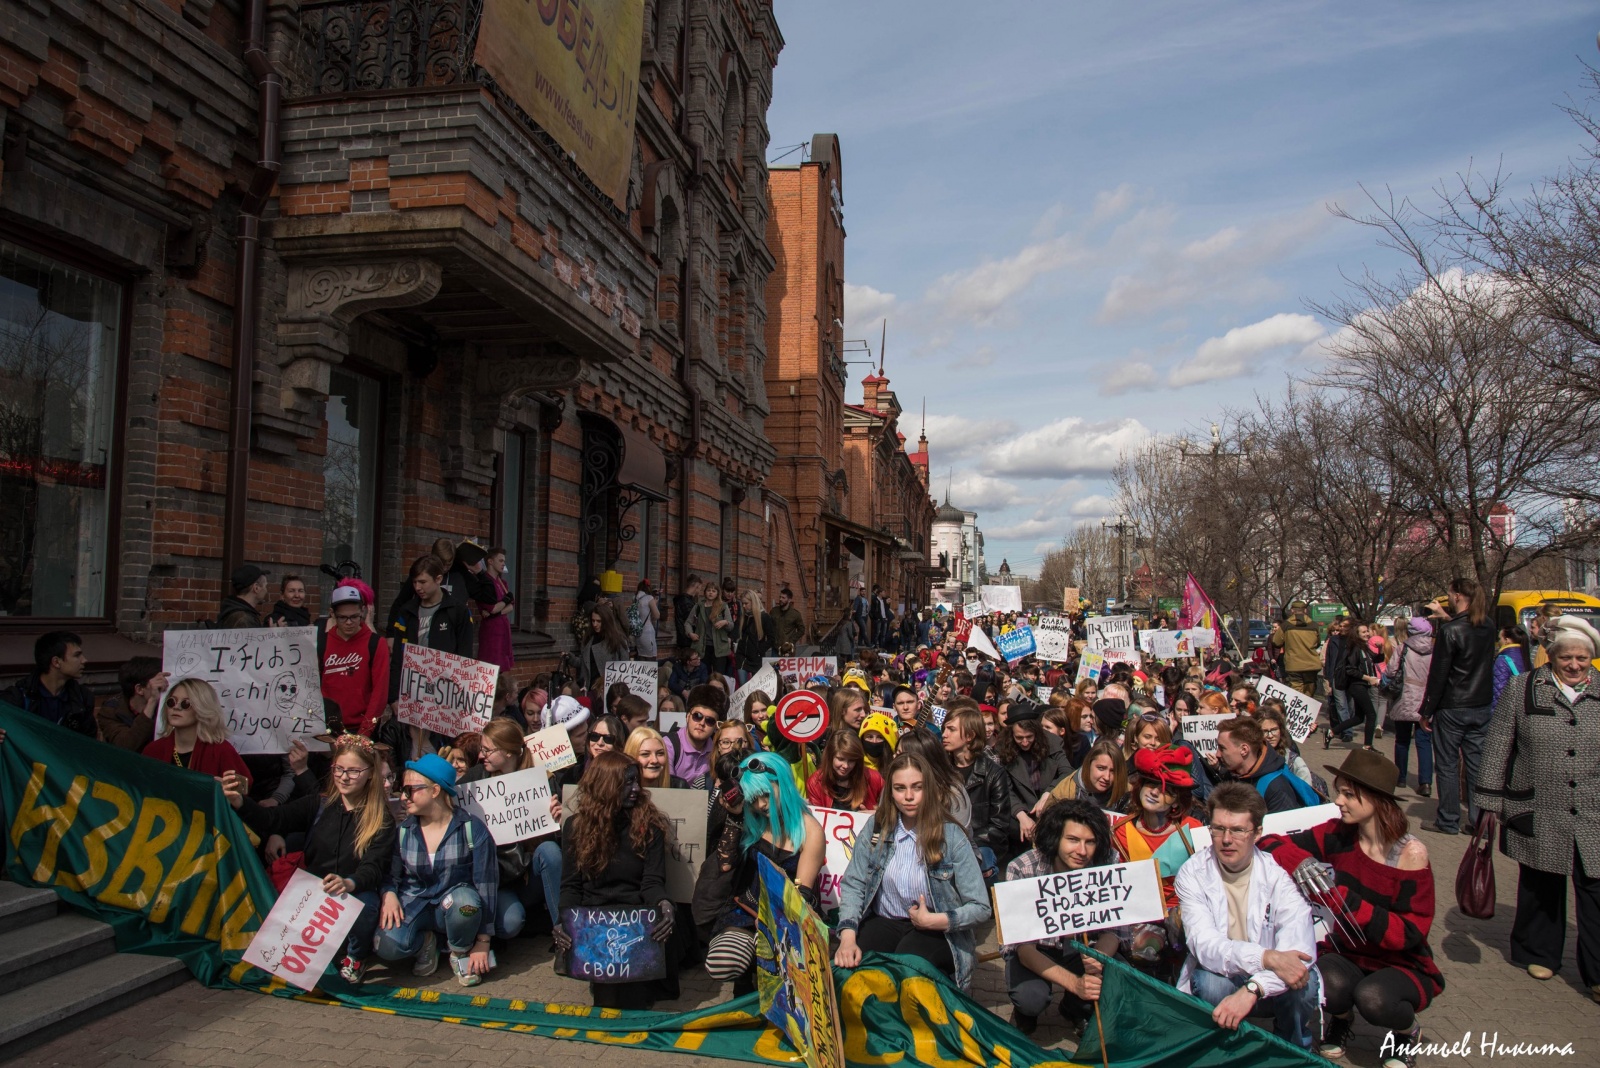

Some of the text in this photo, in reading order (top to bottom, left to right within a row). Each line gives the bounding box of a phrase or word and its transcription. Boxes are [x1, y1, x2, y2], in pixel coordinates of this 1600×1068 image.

[1042, 618, 1064, 626] СЛАВА
[325, 652, 363, 668] Bulls
[778, 657, 826, 673] ВЕРНИ
[400, 667, 427, 704] LIFE
[435, 678, 494, 720] STRANGE
[1265, 684, 1288, 703] ЕСТЬ
[222, 705, 282, 736] hiyou
[1183, 721, 1198, 733] НЕТ
[456, 780, 506, 808] НАЗЛО
[504, 785, 549, 808] ВРАГАМ
[485, 806, 530, 828] РАДОСТЬ
[515, 815, 548, 838] МАМЕ
[1037, 867, 1127, 899] КРЕДИТ
[1035, 885, 1133, 919] БЮДЖЕТУ
[570, 908, 656, 928] У КАЖДОГО
[1043, 906, 1124, 935] ВРЕДИТ
